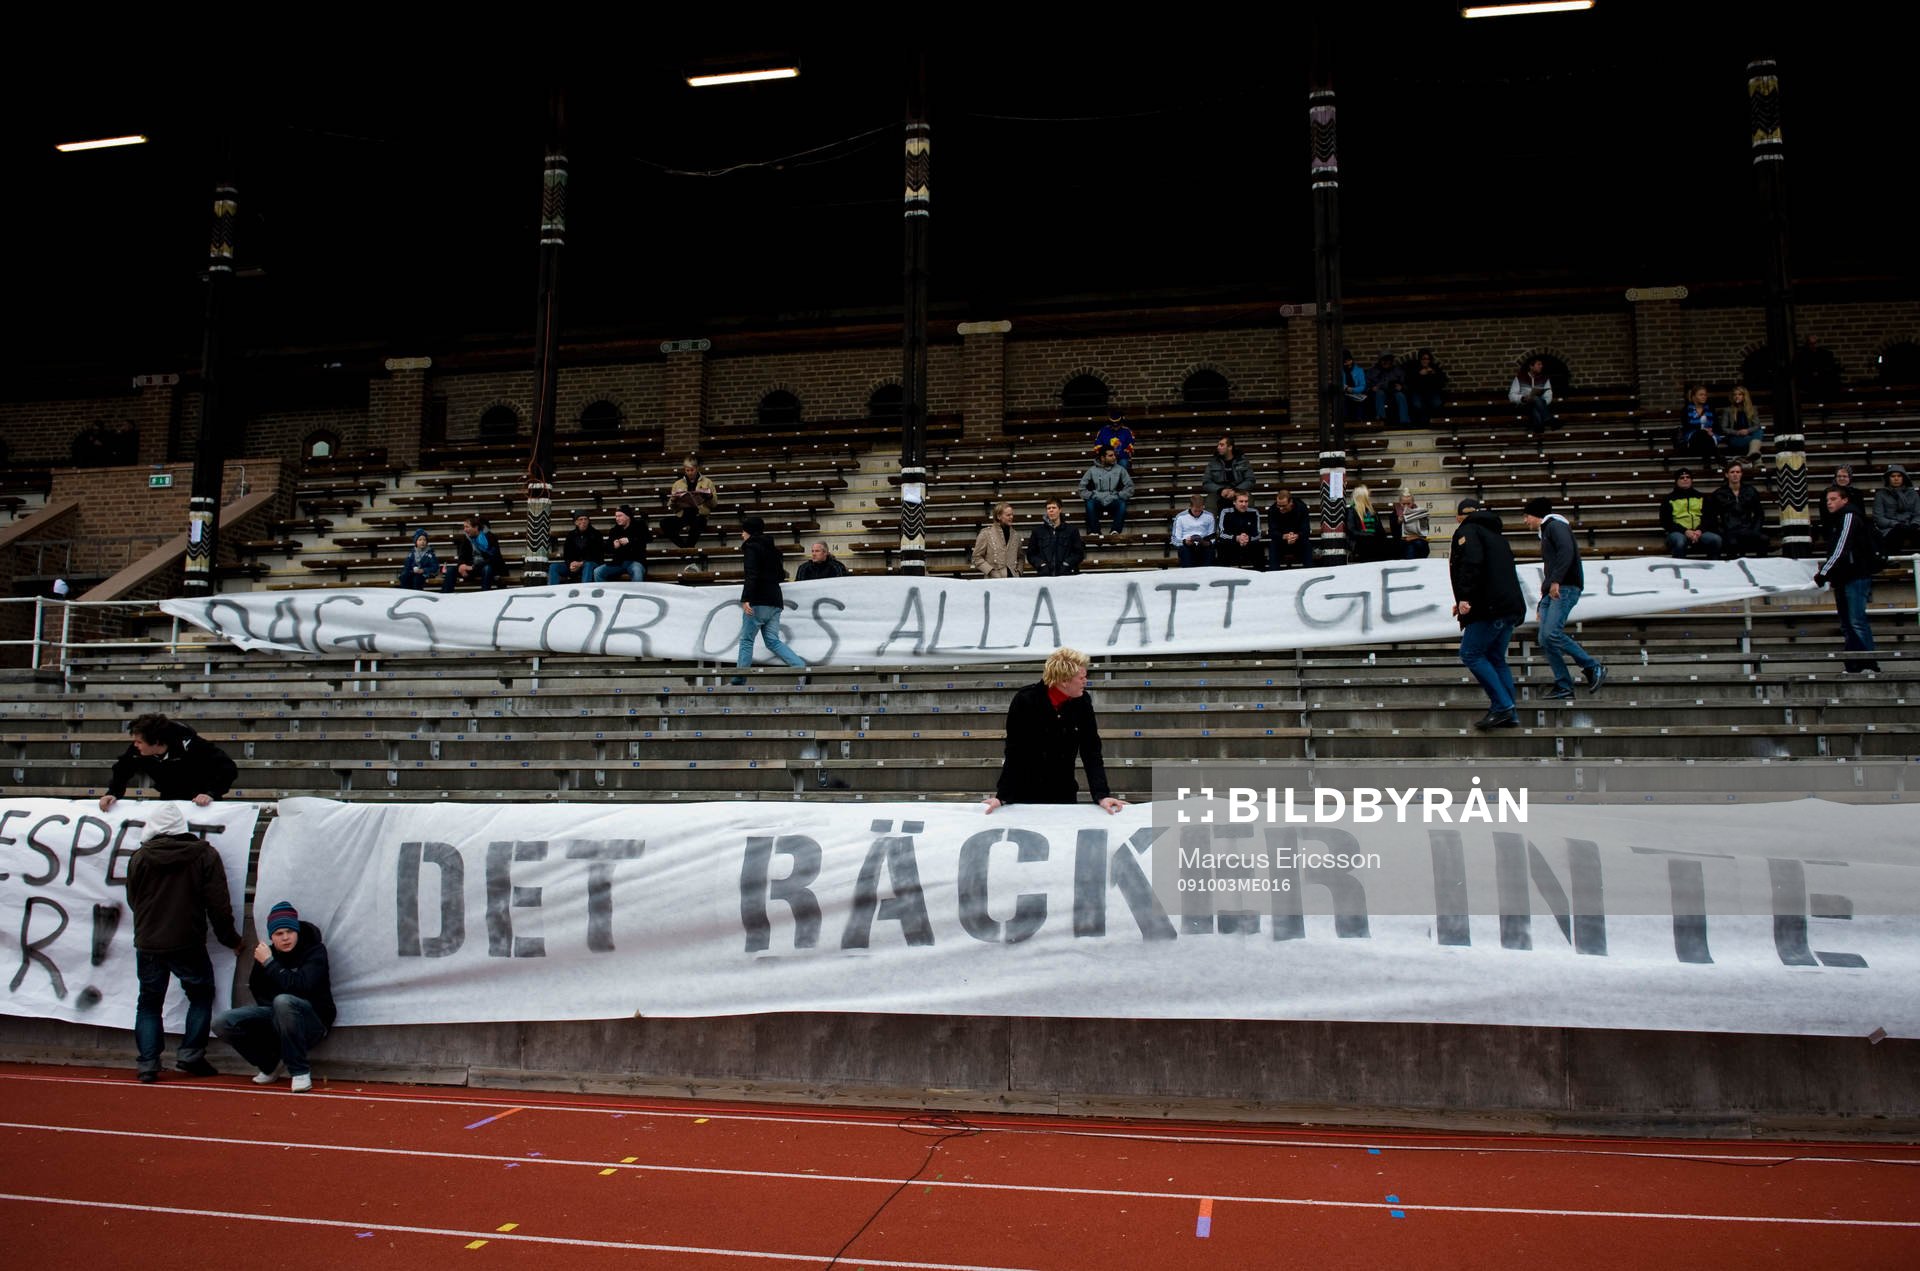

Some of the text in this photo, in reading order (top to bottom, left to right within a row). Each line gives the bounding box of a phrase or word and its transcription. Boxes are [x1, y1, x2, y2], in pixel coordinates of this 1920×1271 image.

[871, 480, 879, 488] 17
[1418, 480, 1427, 489] 16
[1425, 501, 1434, 510] 15
[845, 521, 853, 529] 15
[1433, 525, 1442, 534] 14
[831, 543, 839, 552] 14
[492, 588, 669, 657] FÖR
[876, 586, 1062, 656] ALLA
[1107, 579, 1252, 647] ATT
[1294, 565, 1441, 635] GE
[396, 818, 1870, 969] DET RÄCKER INTE
